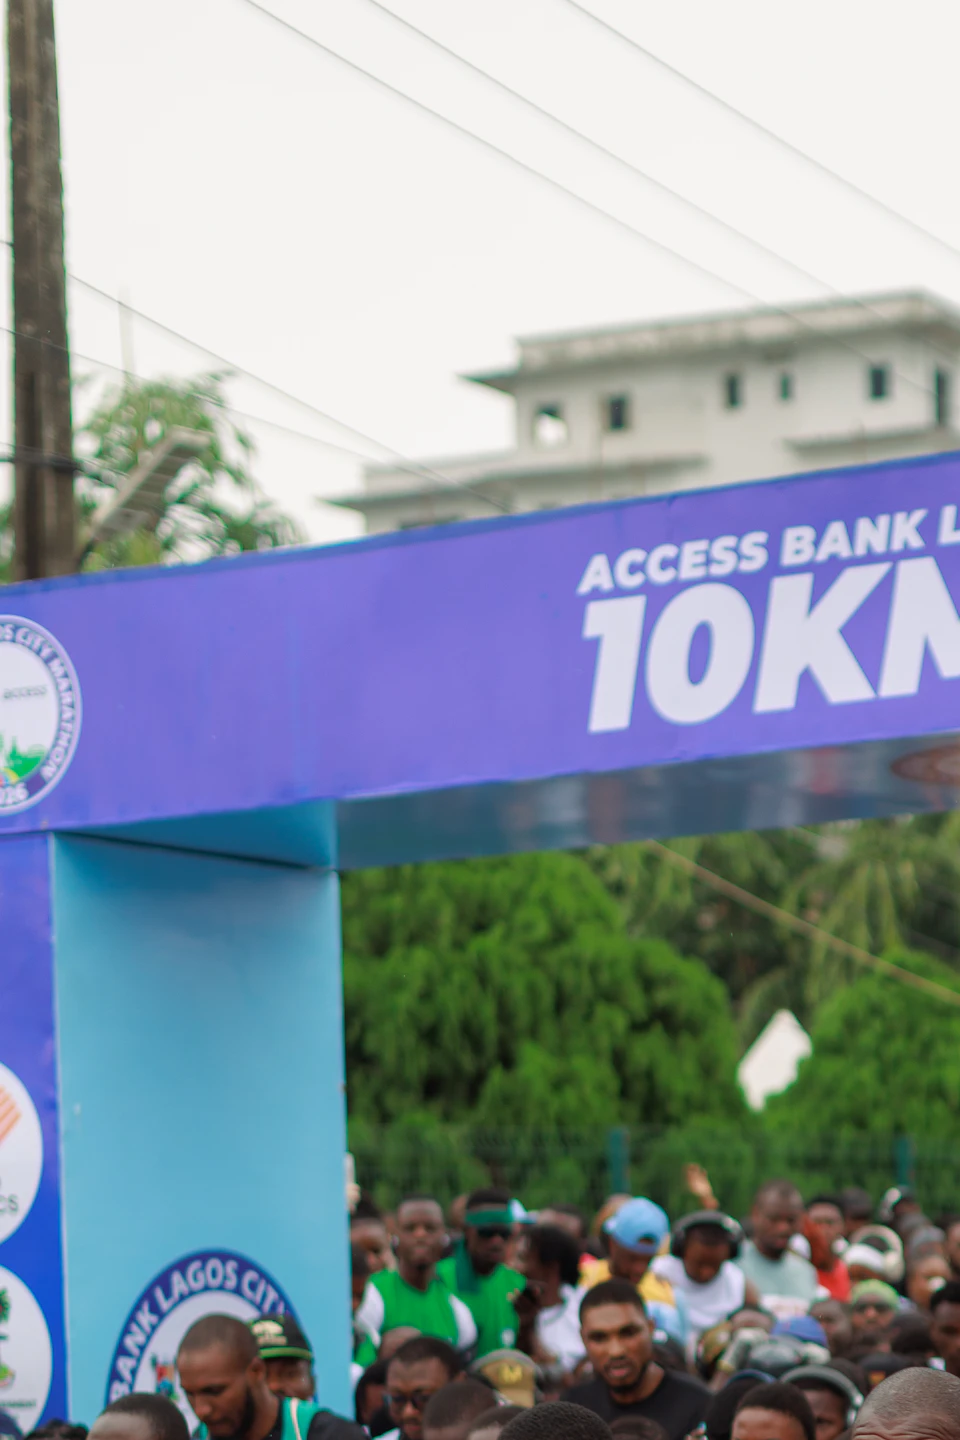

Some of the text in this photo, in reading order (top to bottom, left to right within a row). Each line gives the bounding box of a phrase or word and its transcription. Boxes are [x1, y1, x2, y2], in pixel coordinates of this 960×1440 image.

[576, 531, 769, 595] ACCESS
[781, 508, 928, 567] BANK
[109, 1299, 159, 1403] BANK
[154, 1257, 239, 1313] LAGOS
